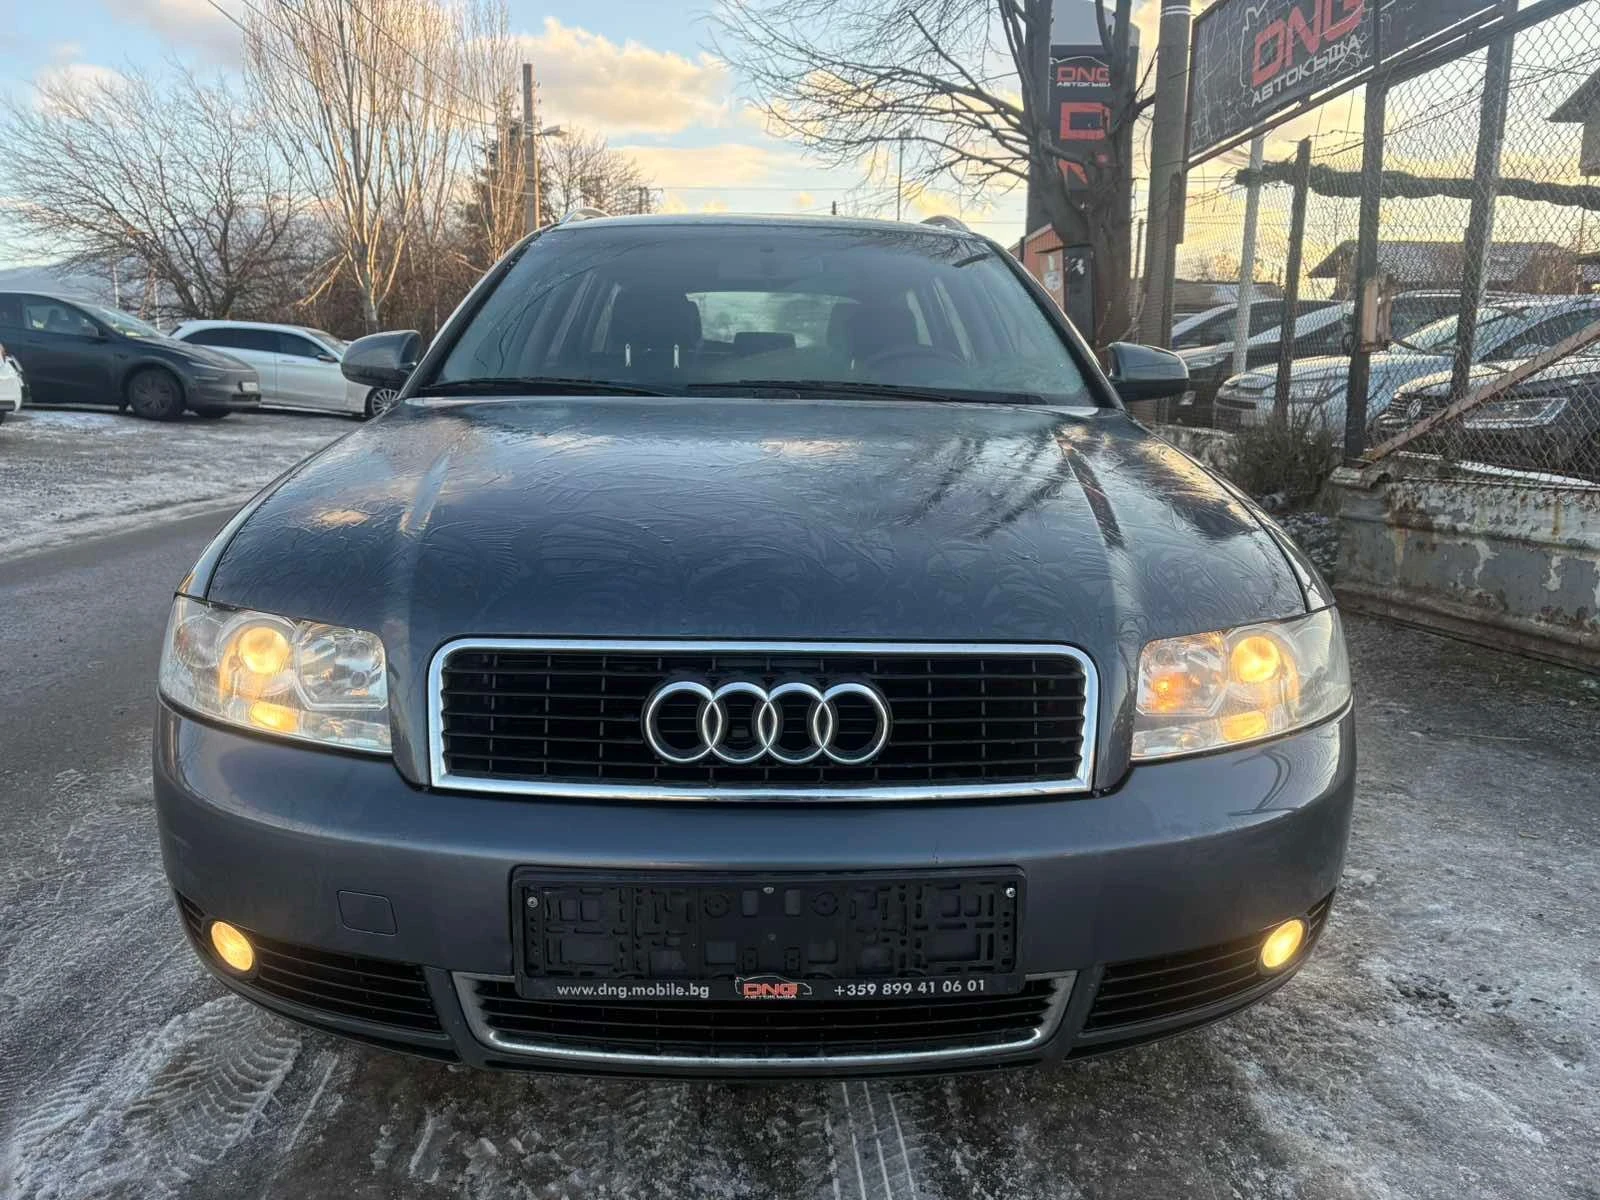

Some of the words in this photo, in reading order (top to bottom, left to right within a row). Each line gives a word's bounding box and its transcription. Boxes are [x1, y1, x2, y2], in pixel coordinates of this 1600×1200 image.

[1252, 0, 1366, 87] DNG
[556, 983, 710, 999] www.dng.mobile.bg
[743, 983, 798, 996] DNG
[834, 983, 877, 996] +359
[882, 982, 913, 995] 899
[917, 981, 935, 994] 41
[942, 980, 962, 993] 06
[967, 979, 985, 992] 01
